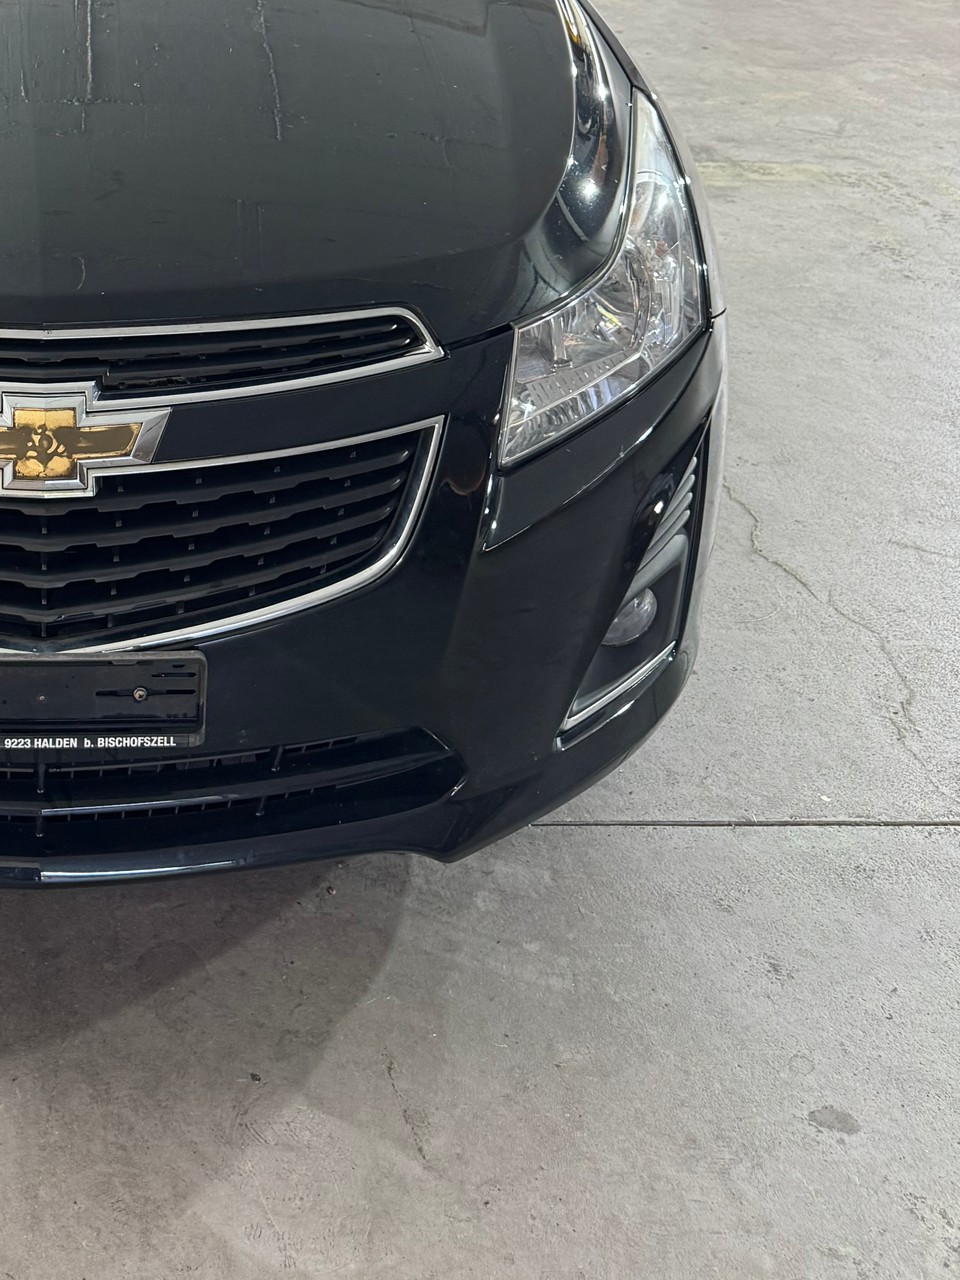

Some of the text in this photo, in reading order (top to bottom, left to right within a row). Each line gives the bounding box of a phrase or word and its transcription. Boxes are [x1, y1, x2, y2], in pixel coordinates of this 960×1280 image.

[4, 737, 31, 748] 9223
[34, 737, 78, 748] HALDEN
[83, 737, 95, 748] b.
[97, 736, 177, 748] BISCHOFSZELL
